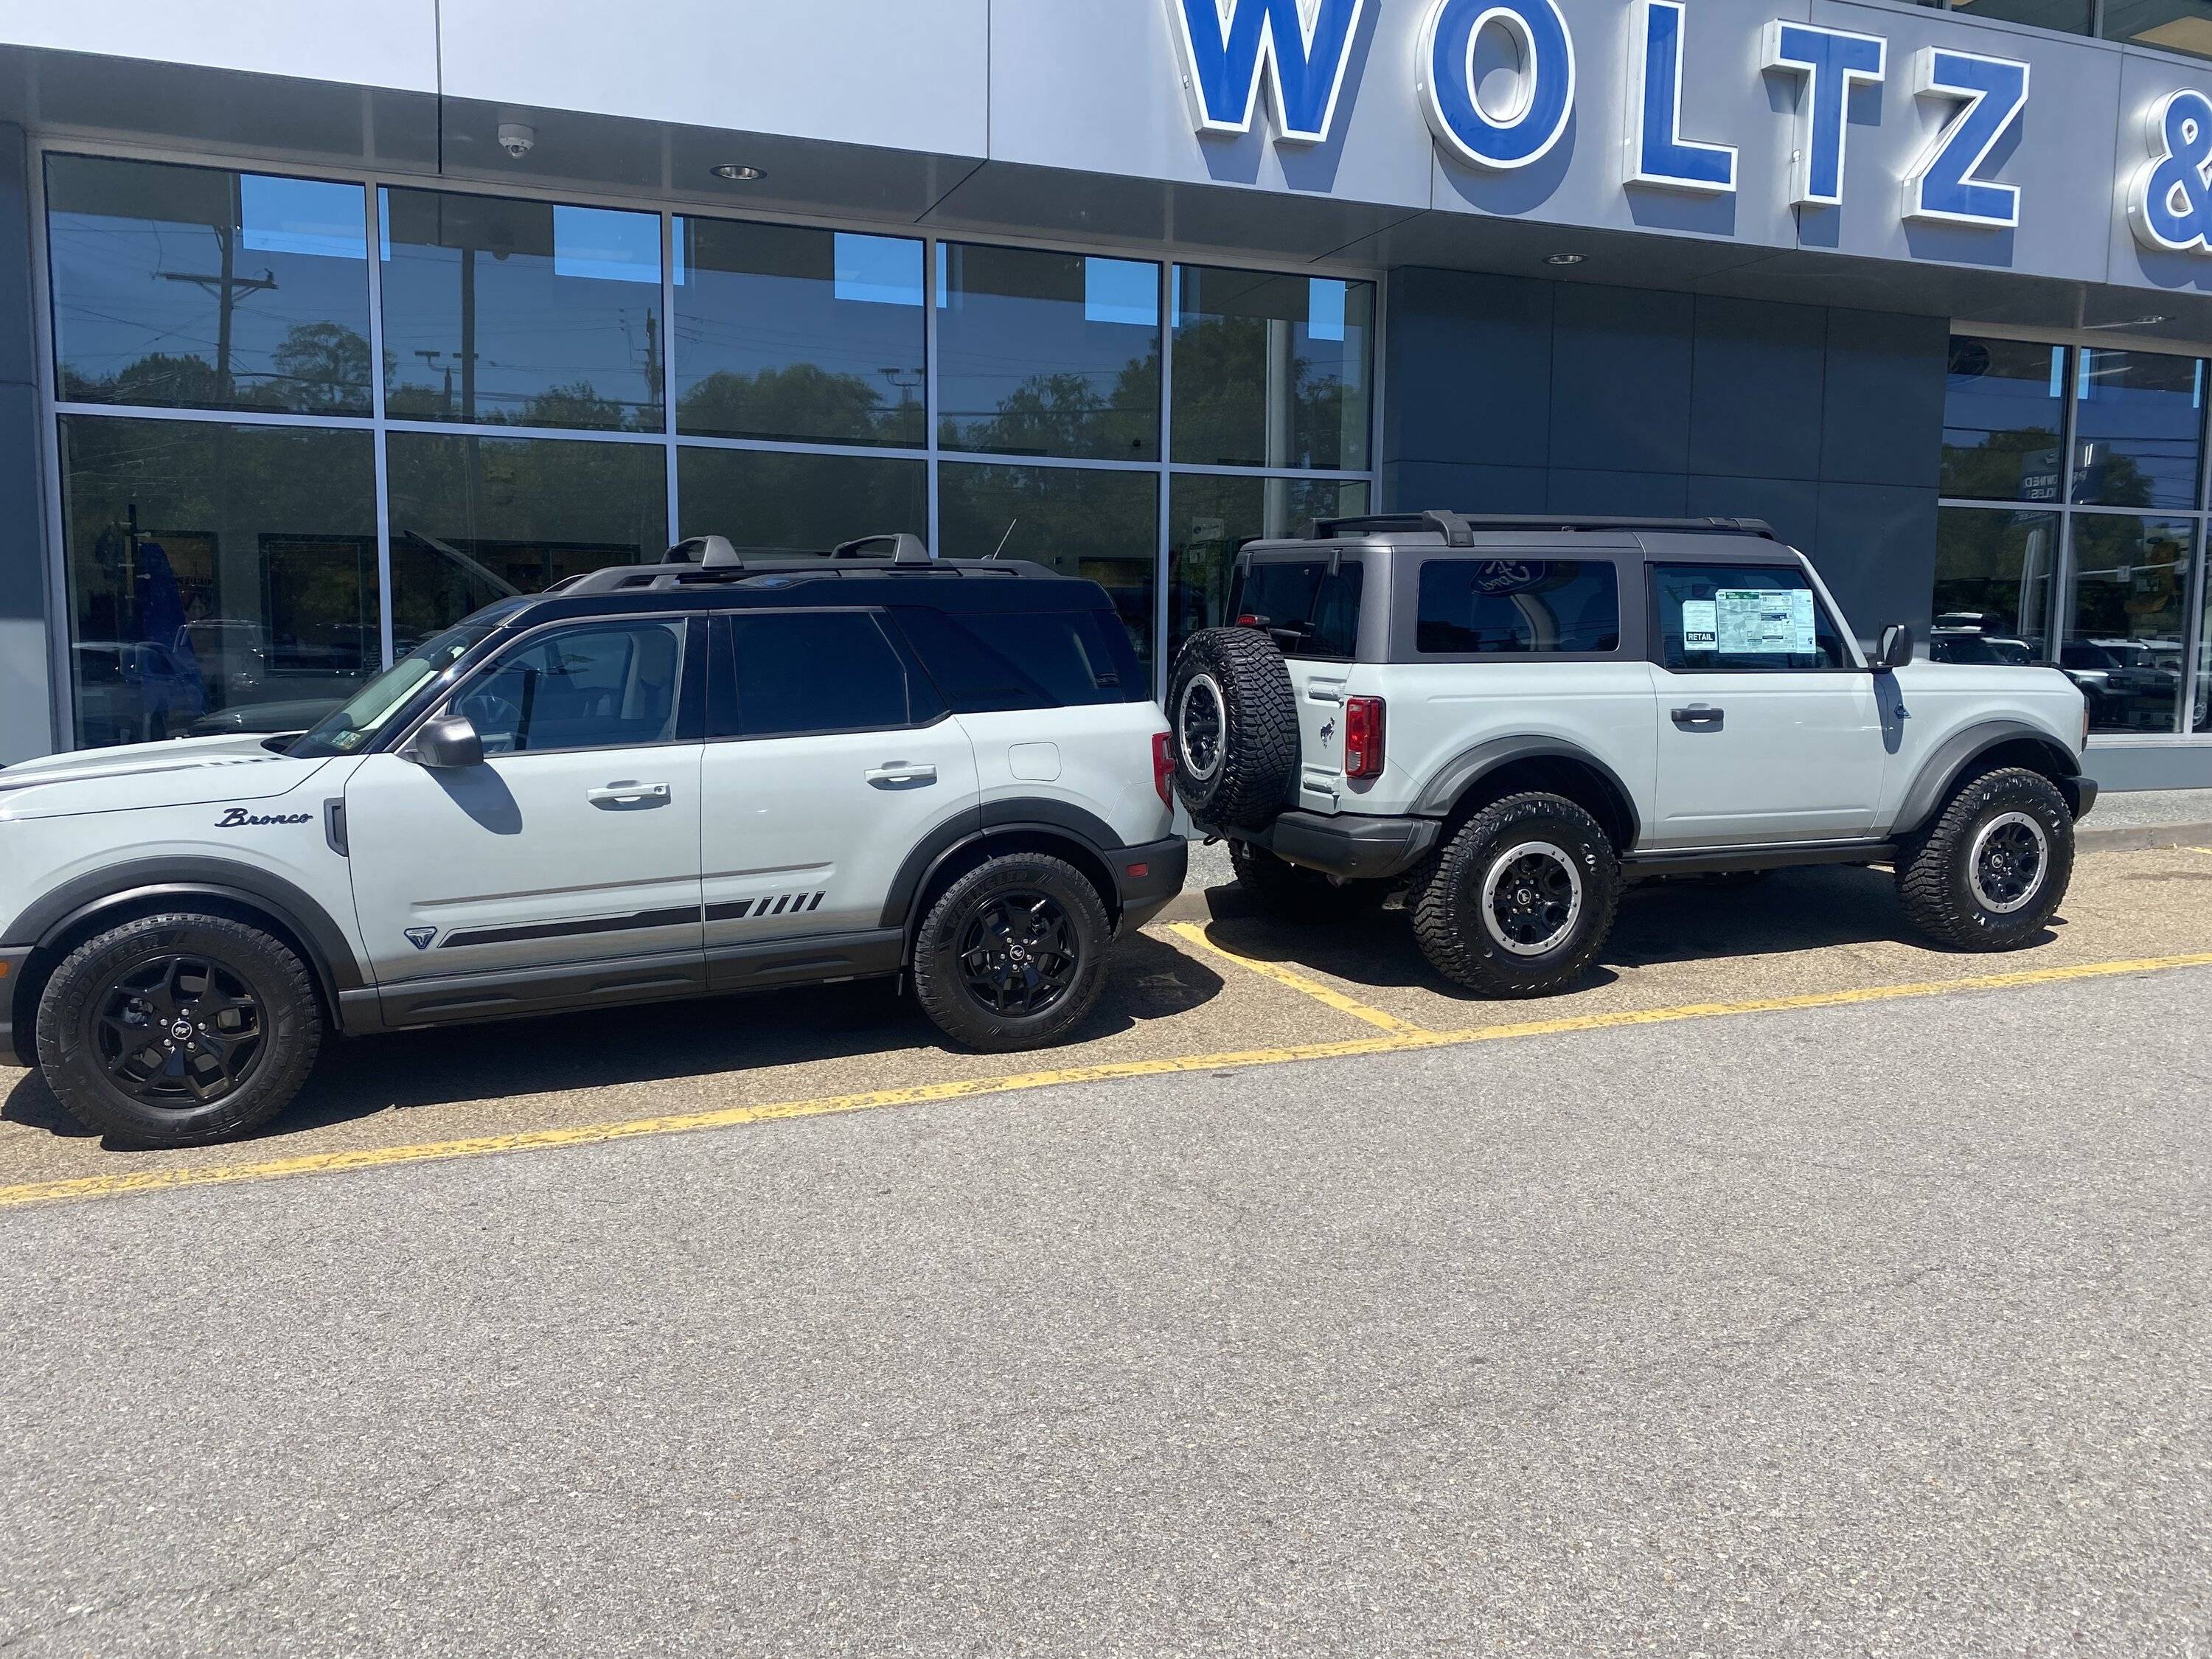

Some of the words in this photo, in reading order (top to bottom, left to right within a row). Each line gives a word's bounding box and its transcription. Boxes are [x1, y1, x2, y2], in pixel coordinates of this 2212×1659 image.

[1171, 0, 2031, 231] WOLTZ
[2131, 88, 2212, 253] &
[1688, 633, 1714, 641] RETAIL
[214, 807, 313, 827] Bronco
